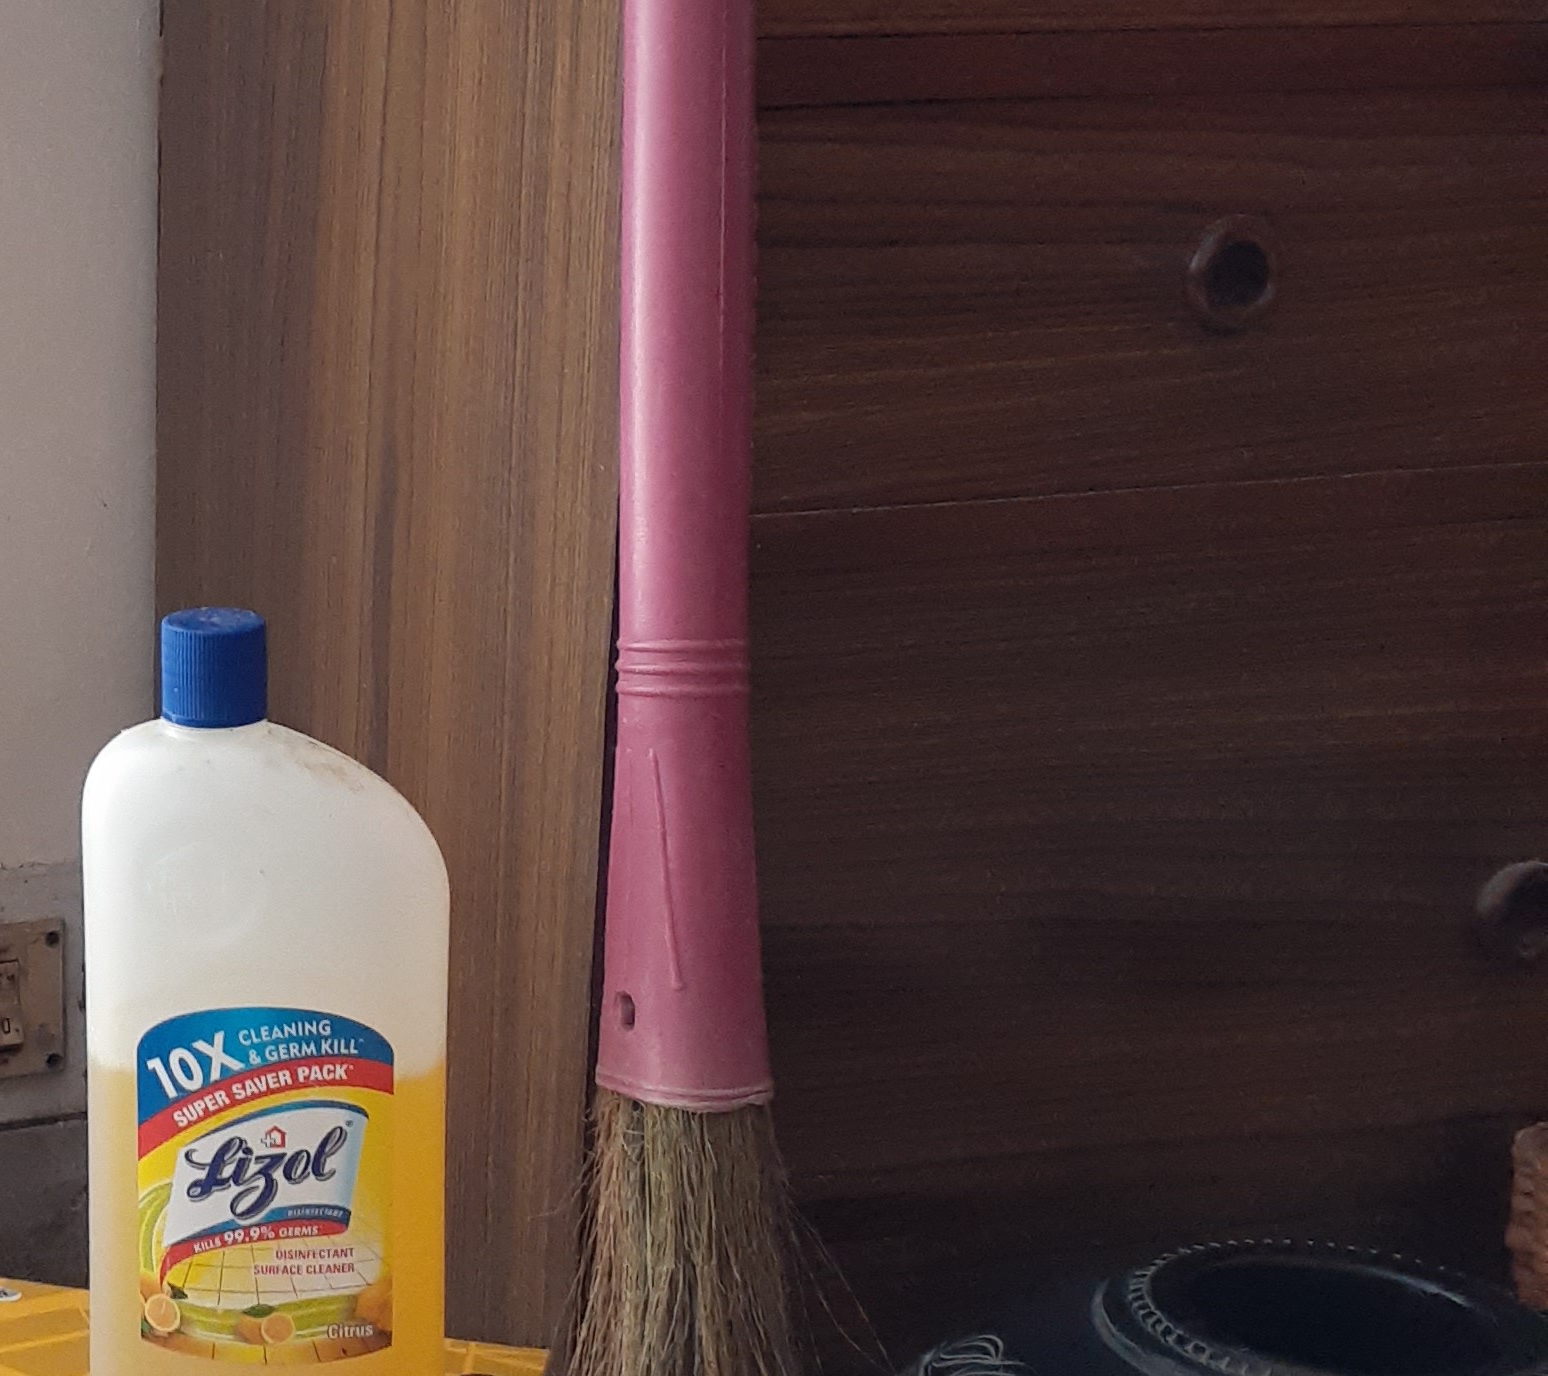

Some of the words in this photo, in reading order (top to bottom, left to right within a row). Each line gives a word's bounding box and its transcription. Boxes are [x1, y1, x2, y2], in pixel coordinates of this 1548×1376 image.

[238, 1019, 331, 1045] CLEANING
[146, 1030, 245, 1100] 10X
[248, 1047, 262, 1066] &
[265, 1042, 318, 1062] GERM
[172, 1089, 231, 1128] SUPER
[231, 1069, 293, 1100] SAVER
[184, 1124, 349, 1221] Lizol
[193, 1236, 222, 1254] KILLS
[223, 1224, 275, 1246] 99.9%
[275, 1247, 354, 1261] DISINFECTANT
[253, 1264, 303, 1276] SURFACE
[305, 1263, 355, 1275] CLEANER
[326, 1322, 374, 1340] Citrus
